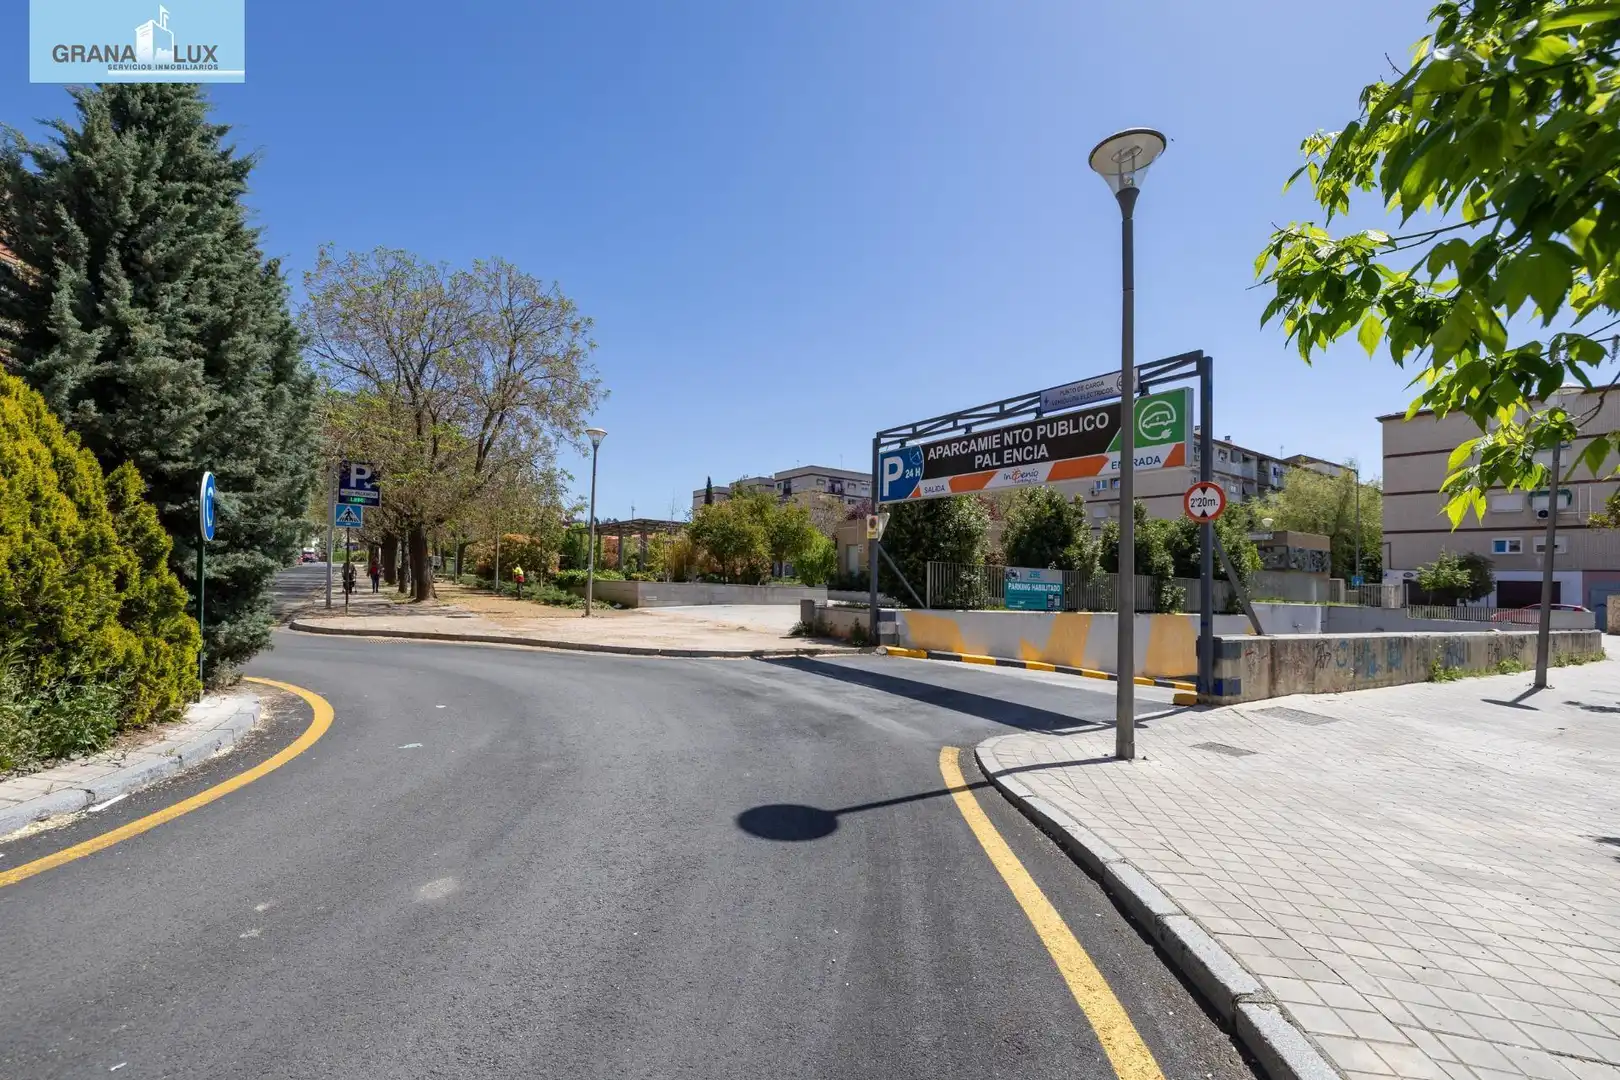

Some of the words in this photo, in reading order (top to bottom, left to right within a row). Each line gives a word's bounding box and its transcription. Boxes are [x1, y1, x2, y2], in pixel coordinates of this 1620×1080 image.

[1085, 380, 1105, 390] CARGA
[928, 428, 1033, 461] APARCAMIENTO
[1036, 412, 1110, 441] PUBLICO
[974, 443, 1049, 469] PALENCIA
[1111, 455, 1162, 470] ENRADA
[350, 463, 372, 488] P
[883, 456, 904, 497] P
[905, 469, 914, 478] 24
[915, 467, 921, 477] H
[924, 484, 946, 494] SALIDA
[1008, 582, 1031, 592] PARKING
[1031, 583, 1061, 592] HABILITADO
